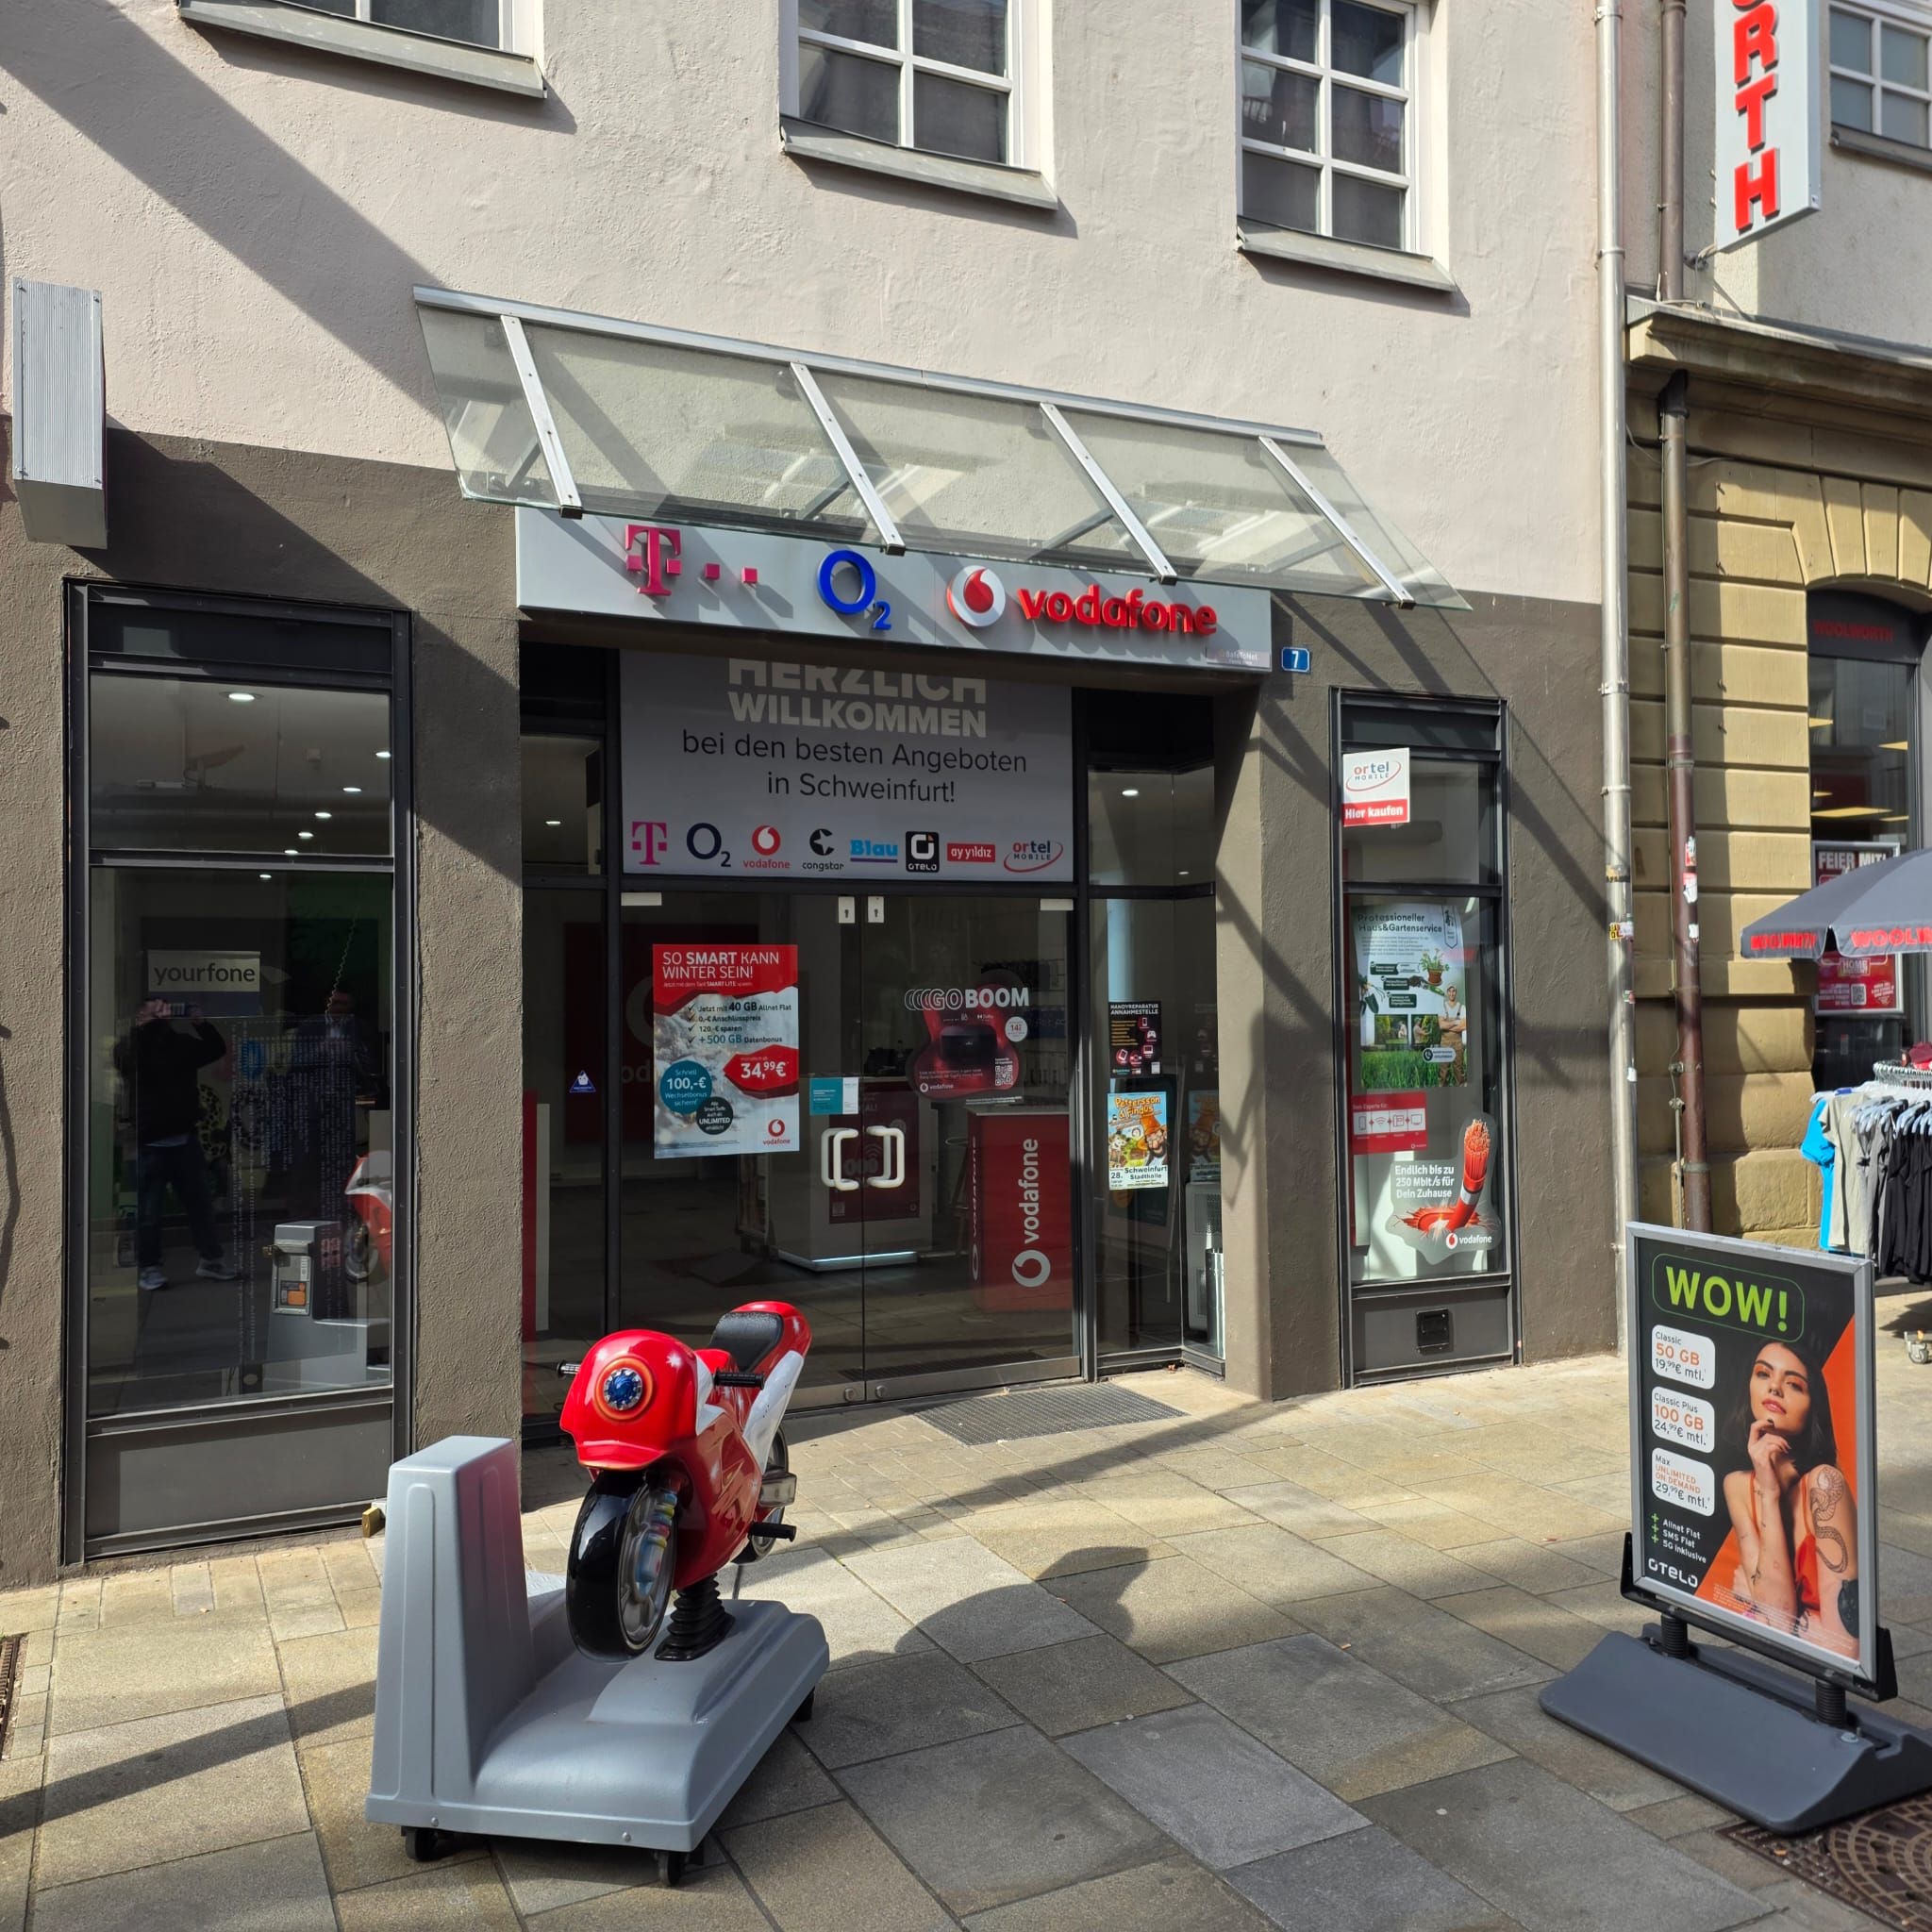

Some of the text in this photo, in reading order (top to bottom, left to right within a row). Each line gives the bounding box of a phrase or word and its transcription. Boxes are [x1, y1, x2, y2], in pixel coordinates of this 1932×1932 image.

[1734, 0, 1780, 235] RTH
[1017, 584, 1217, 635] vodafone
[1291, 650, 1299, 669] 7
[727, 691, 987, 738] WILLKOMMEN
[683, 729, 1026, 774] bei den besten Angeboten
[1354, 761, 1390, 774] ortel
[1355, 773, 1390, 781] MOBILE
[767, 772, 955, 802] in Schweinfurt!
[1345, 805, 1404, 819] Hier kaufen
[850, 840, 898, 857] Blau
[951, 845, 964, 858] ay
[1012, 840, 1050, 853] ortel
[742, 859, 790, 869] vodafone
[802, 861, 844, 872] congstar
[1818, 851, 1856, 870] FEIER
[1357, 912, 1425, 922] Professioneller
[1358, 923, 1442, 933] Haus&Gartenservice
[662, 951, 779, 965] SO SMART KANN
[154, 962, 256, 986] yourfone
[662, 965, 753, 979] WINTER SEIN!
[728, 1002, 741, 1011] 40
[743, 1002, 757, 1010] GB
[708, 1035, 725, 1044] 500
[728, 1035, 741, 1043] GB
[1124, 1165, 1167, 1174] Schweinfurt
[1394, 1164, 1455, 1175] Endlich bis zu
[1413, 1175, 1441, 1188] Mbit/s
[1441, 1175, 1455, 1186] für
[1017, 1138, 1039, 1244] vodafone
[1396, 1188, 1453, 1199] Dein Zuhause
[1459, 1235, 1492, 1244] vodafone
[1666, 1265, 1788, 1332] WOW!
[1655, 1331, 1682, 1345] Classic
[1656, 1342, 1700, 1366] 50 GB
[1654, 1392, 1699, 1413] Classic Plus
[1655, 1404, 1704, 1431] 100 GB
[1655, 1454, 1671, 1466] Max
[1655, 1463, 1696, 1484] UNLIMITED
[1655, 1472, 1701, 1493] ON DEMAND
[1662, 1518, 1701, 1540] Allnet Flat
[1662, 1529, 1695, 1548] SMS Flat
[1662, 1540, 1674, 1550] 5G
